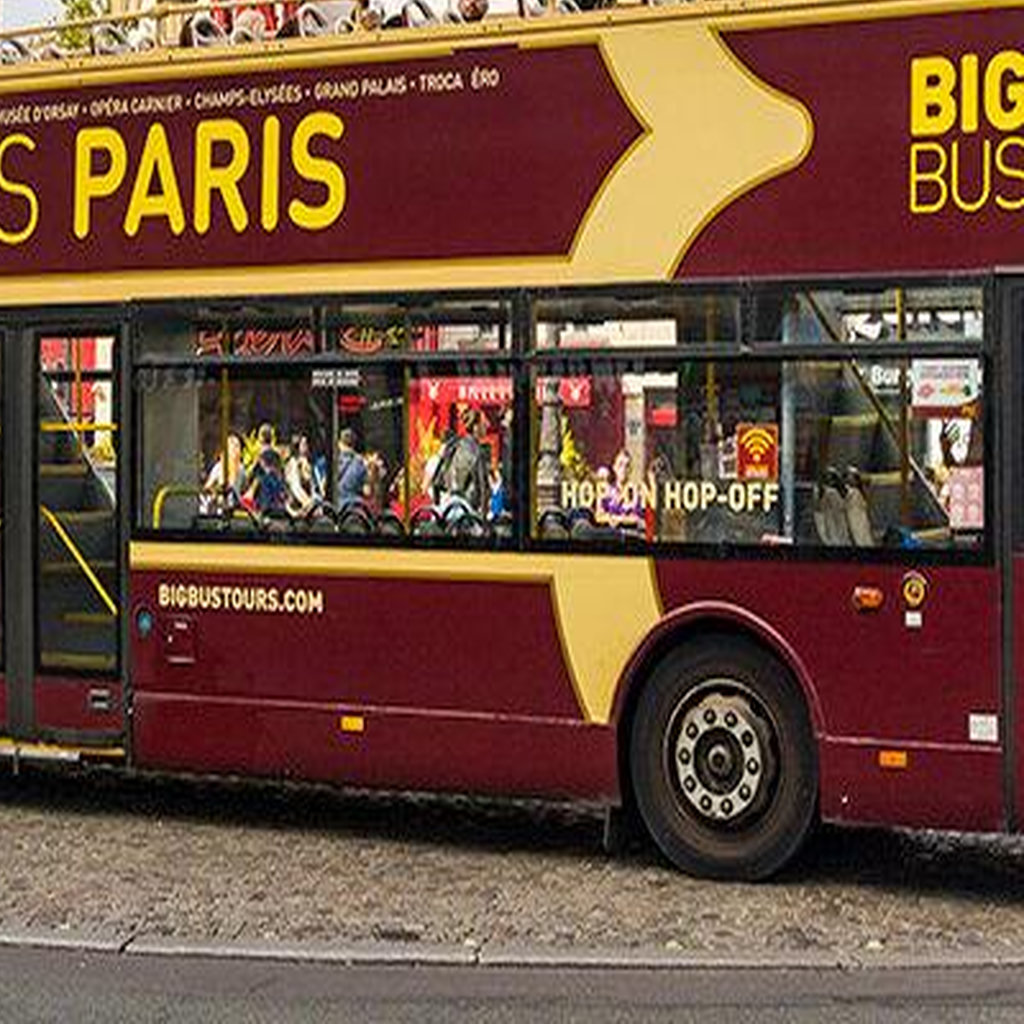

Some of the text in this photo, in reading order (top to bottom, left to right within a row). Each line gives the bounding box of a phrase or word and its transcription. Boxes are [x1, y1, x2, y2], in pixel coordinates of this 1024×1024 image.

[361, 76, 407, 96] PALAIS
[910, 52, 1024, 137] BIG
[73, 111, 346, 239] PARIS
[910, 138, 1024, 214] BUS
[665, 481, 780, 512] HOP-OFF
[158, 583, 324, 614] BIGBUSTOURS.COM
